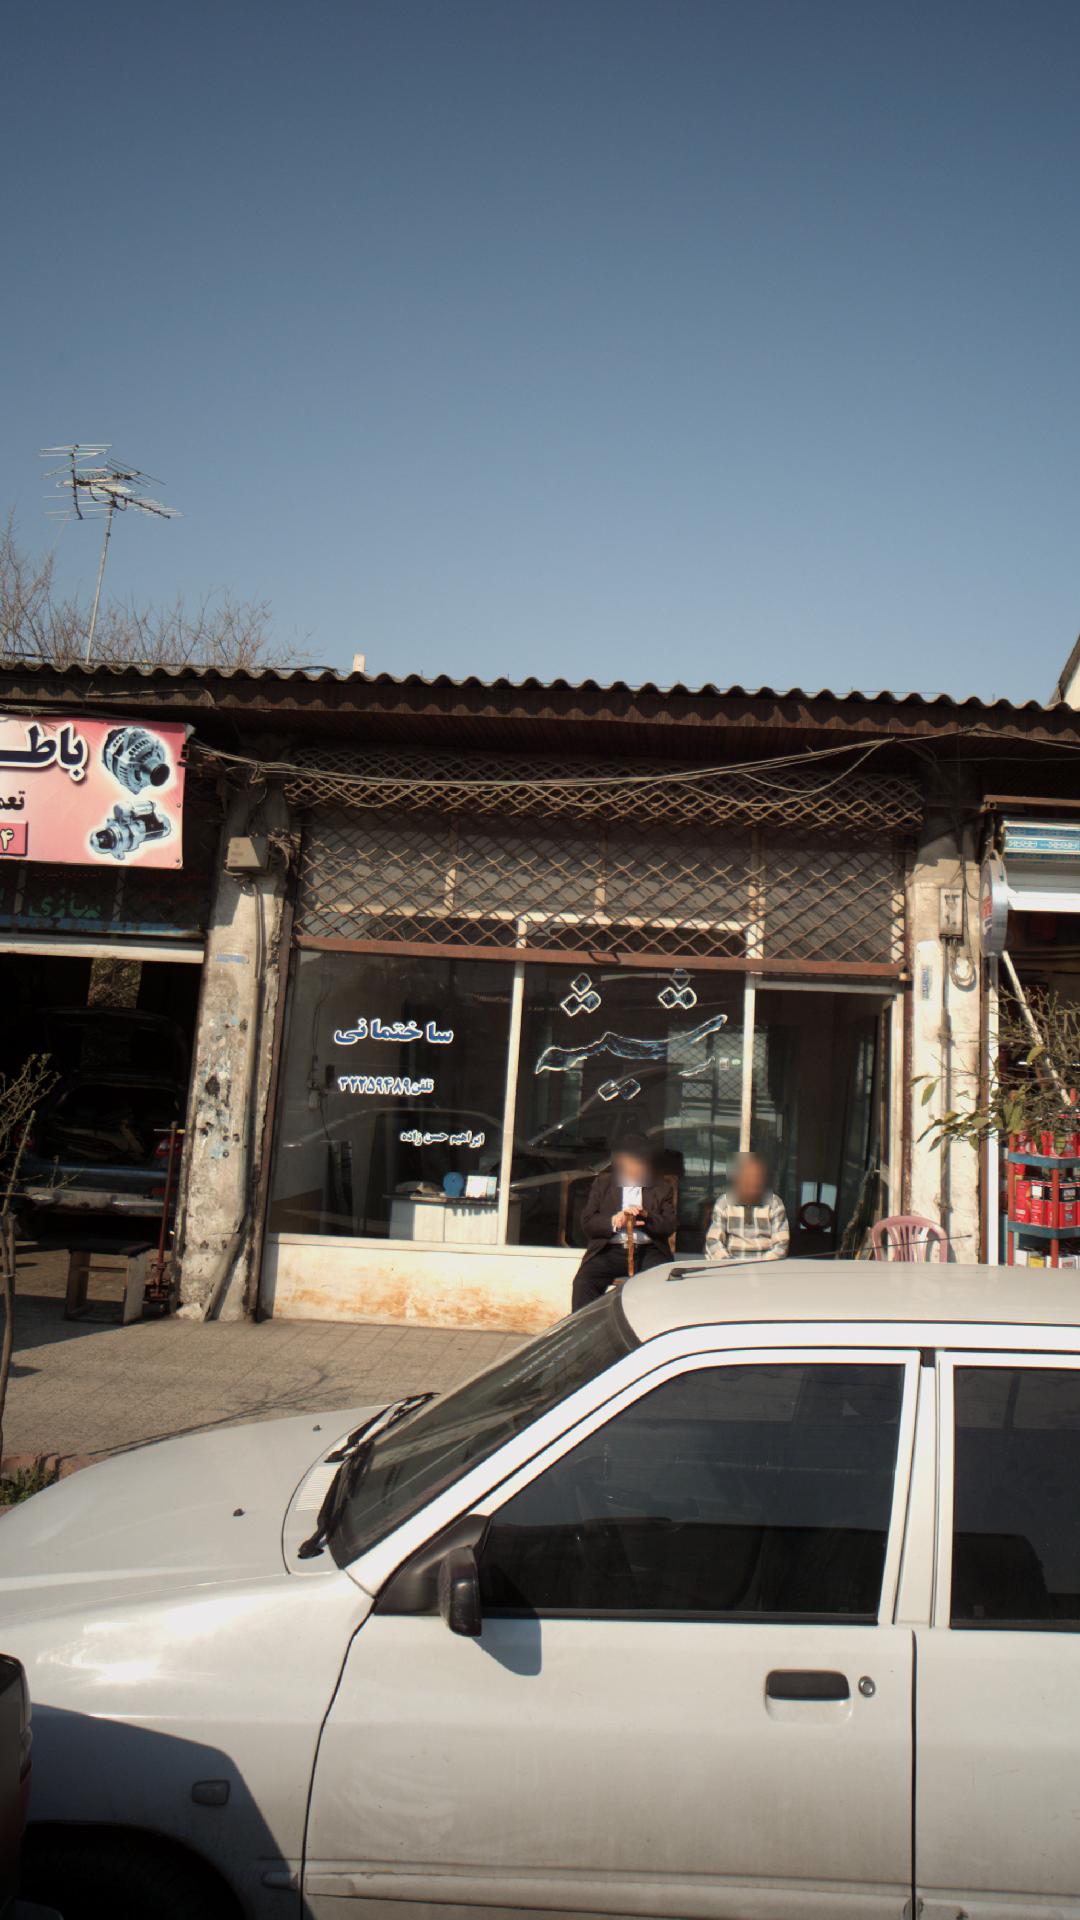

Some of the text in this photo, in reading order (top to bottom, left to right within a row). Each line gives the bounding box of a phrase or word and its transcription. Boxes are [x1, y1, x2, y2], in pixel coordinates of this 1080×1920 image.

[0, 723, 88, 781] باط
[400, 1129, 423, 1146] زاده
[423, 1132, 449, 1145] حسن
